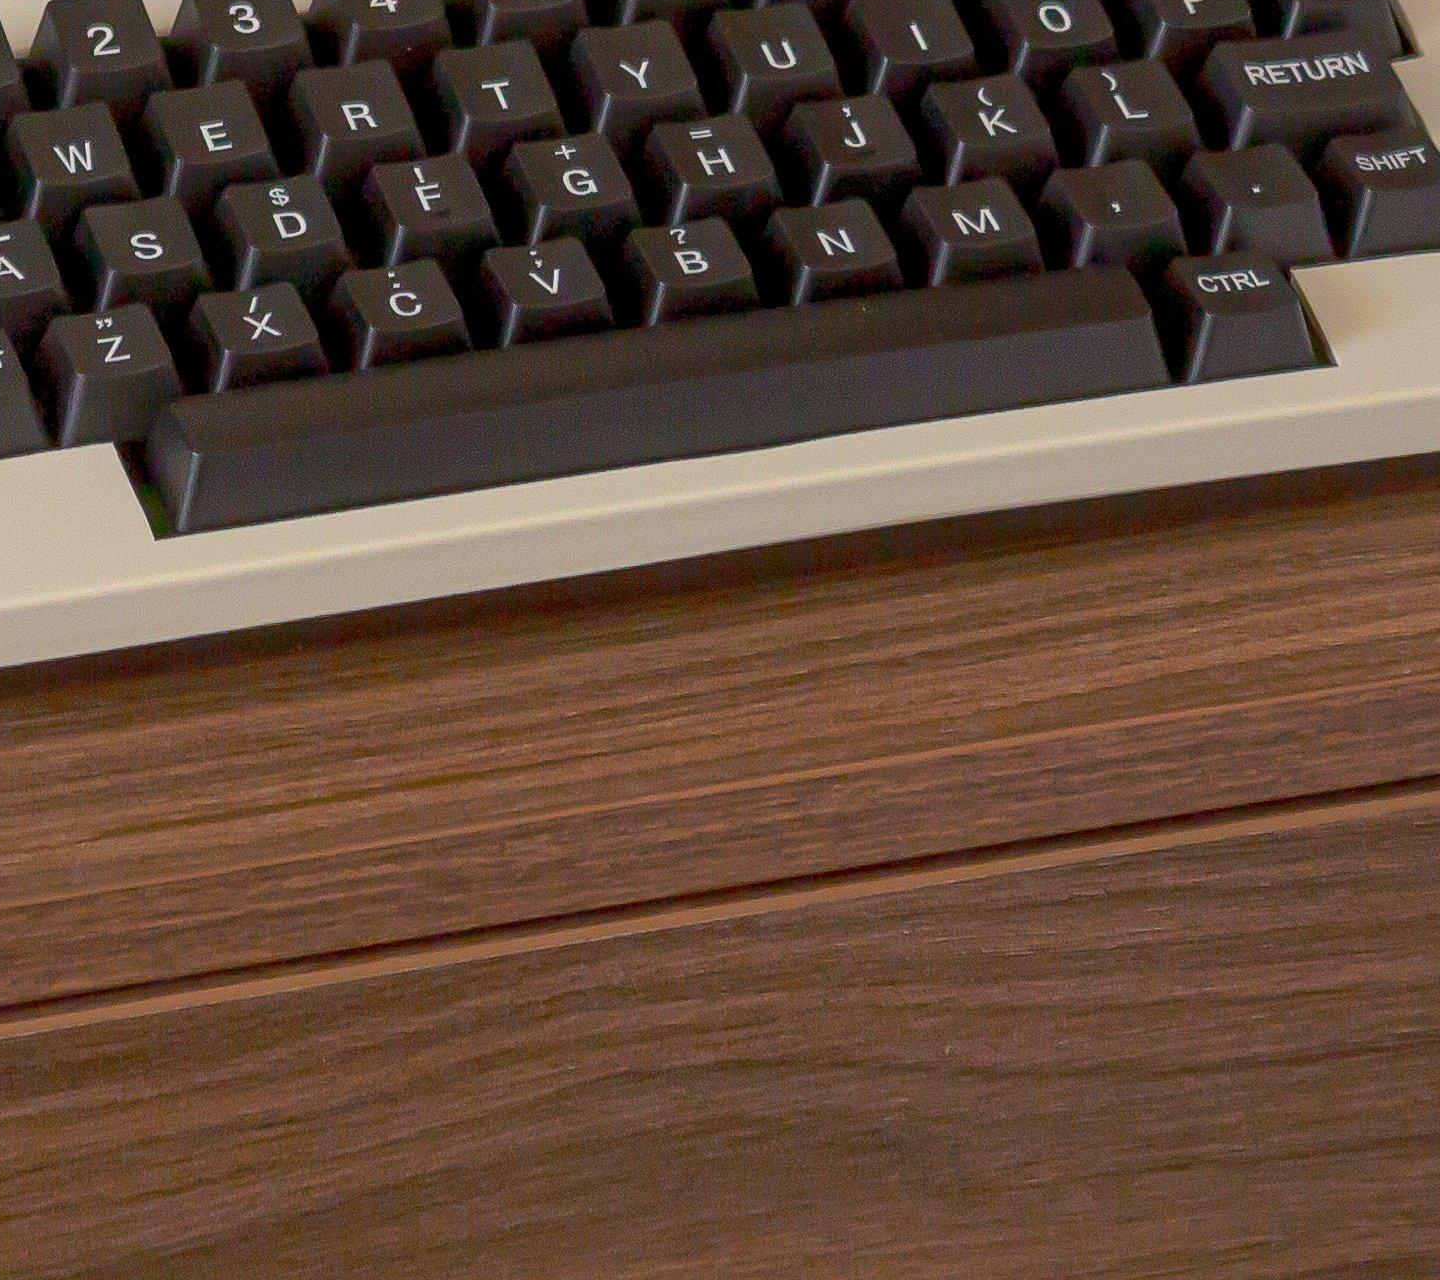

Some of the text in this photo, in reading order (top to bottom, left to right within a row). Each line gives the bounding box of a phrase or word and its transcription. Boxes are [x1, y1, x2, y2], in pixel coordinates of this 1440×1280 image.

[228, 5, 261, 33] 3
[87, 26, 120, 56] 2
[761, 41, 798, 69] U
[620, 61, 649, 88] Y
[1244, 52, 1369, 86] RETURN
[481, 80, 509, 109] T
[1114, 95, 1149, 119] L
[341, 102, 377, 130] R
[979, 109, 1017, 136] K
[199, 121, 232, 151] E
[54, 141, 93, 174] W
[697, 148, 735, 175] H
[1355, 147, 1425, 172] SHIFT
[562, 169, 597, 196] G
[273, 211, 307, 238] D
[952, 208, 1000, 235] M
[131, 233, 163, 259] S
[817, 229, 855, 255] N
[674, 250, 709, 275] B
[529, 269, 560, 295] V
[1198, 269, 1270, 293] CTRL
[389, 292, 422, 317] C
[242, 312, 281, 339] X
[97, 336, 130, 363] Z
